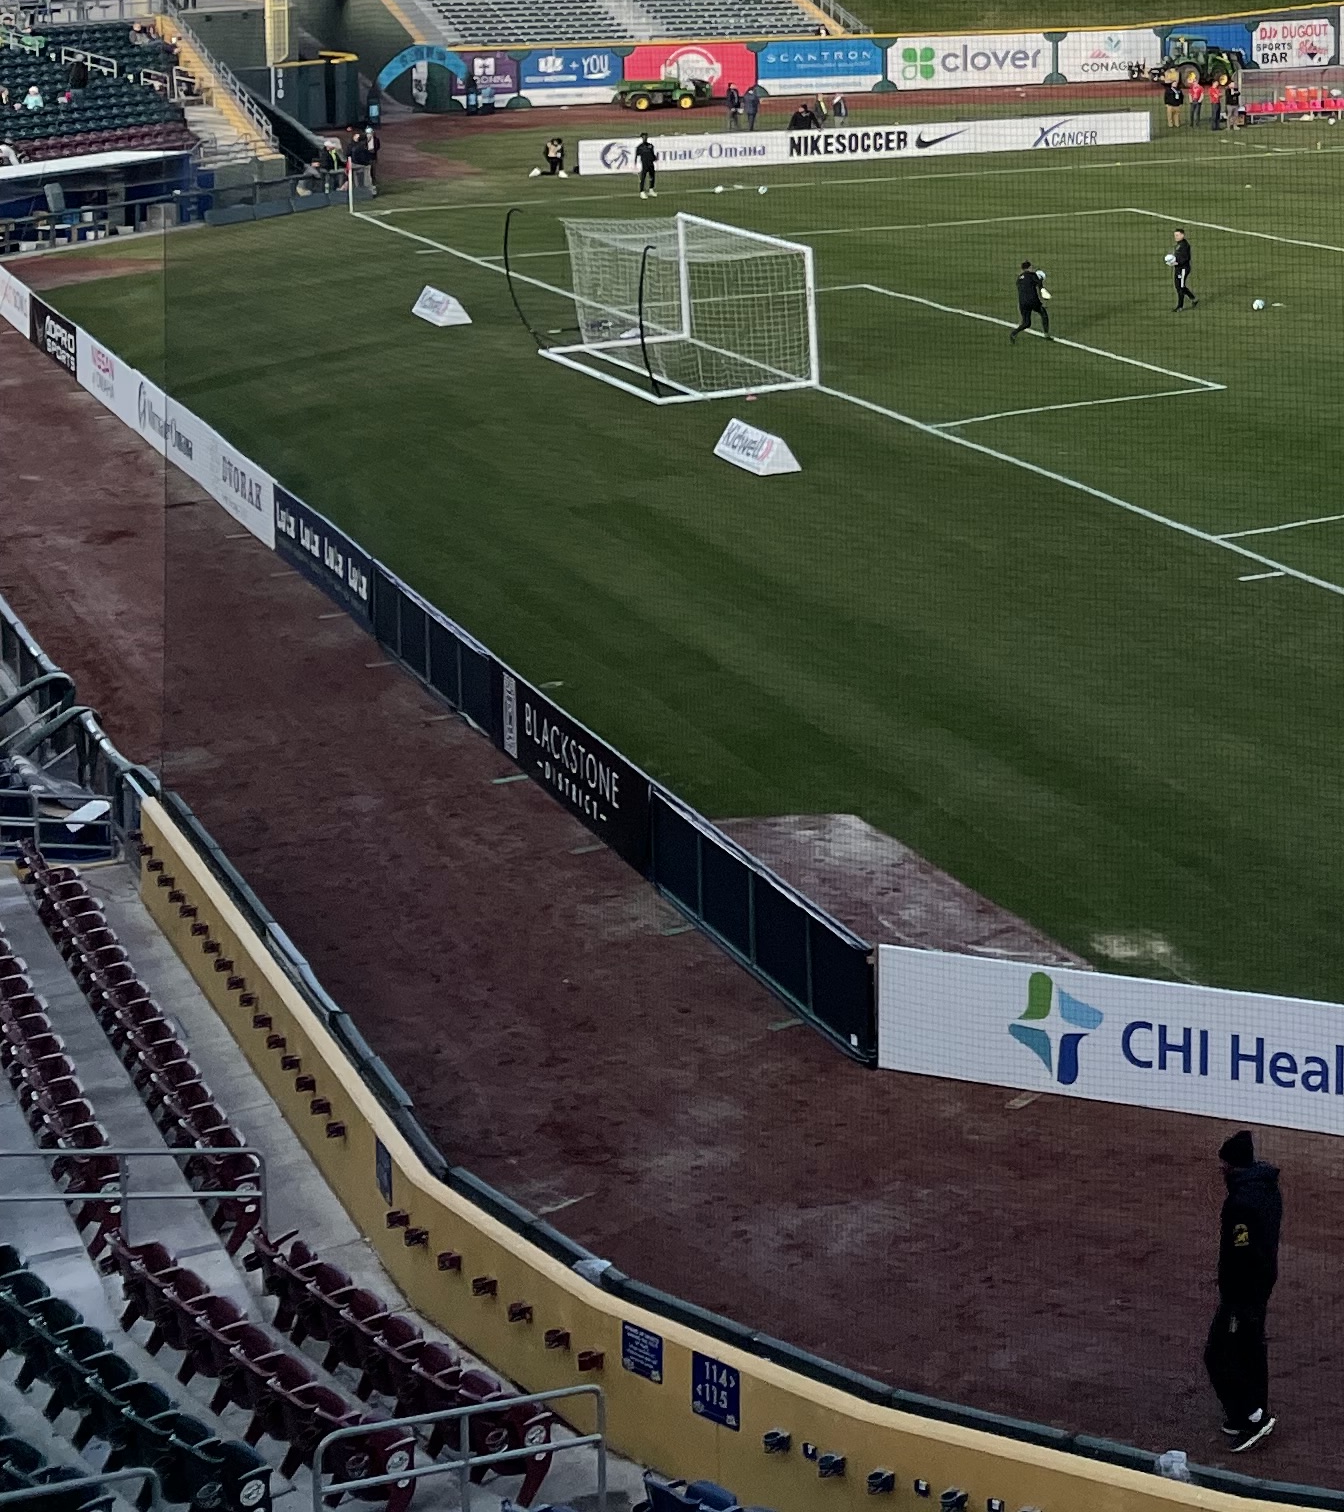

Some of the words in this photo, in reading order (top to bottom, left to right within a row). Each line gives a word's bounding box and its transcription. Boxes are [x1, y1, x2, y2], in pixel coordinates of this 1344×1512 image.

[1282, 23, 1329, 39] DUGOUT
[766, 50, 873, 64] SCANTRON
[940, 44, 1041, 72] clover
[1256, 42, 1293, 51] SPORTS
[1261, 52, 1288, 65] BAR
[581, 54, 610, 74] YOU
[723, 422, 765, 459] Kidwell
[222, 454, 263, 512] DVORAK
[524, 702, 620, 809] BLACKSTONE
[1120, 1020, 1209, 1077] CHI
[704, 1361, 728, 1388] 114
[704, 1383, 728, 1409] 115
